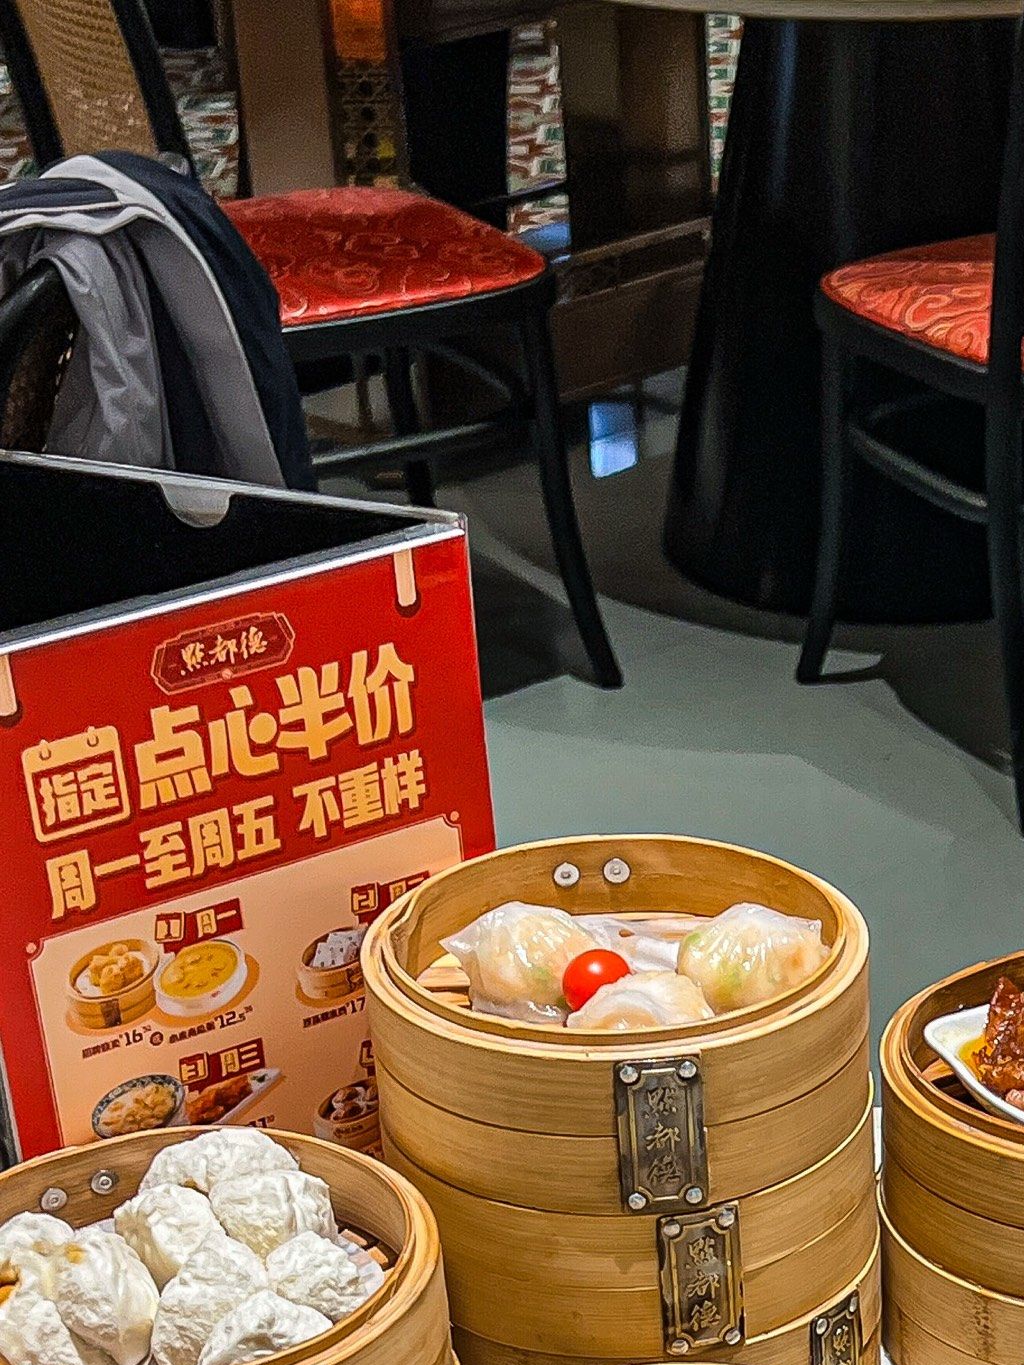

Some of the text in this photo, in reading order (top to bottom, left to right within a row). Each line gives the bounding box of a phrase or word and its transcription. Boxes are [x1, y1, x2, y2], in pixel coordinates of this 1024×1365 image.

[39, 642, 415, 827] 指定 点心半价
[45, 749, 427, 920] 周一至周五 不重样
[196, 908, 238, 938] 周一
[221, 1043, 261, 1077] 周三
